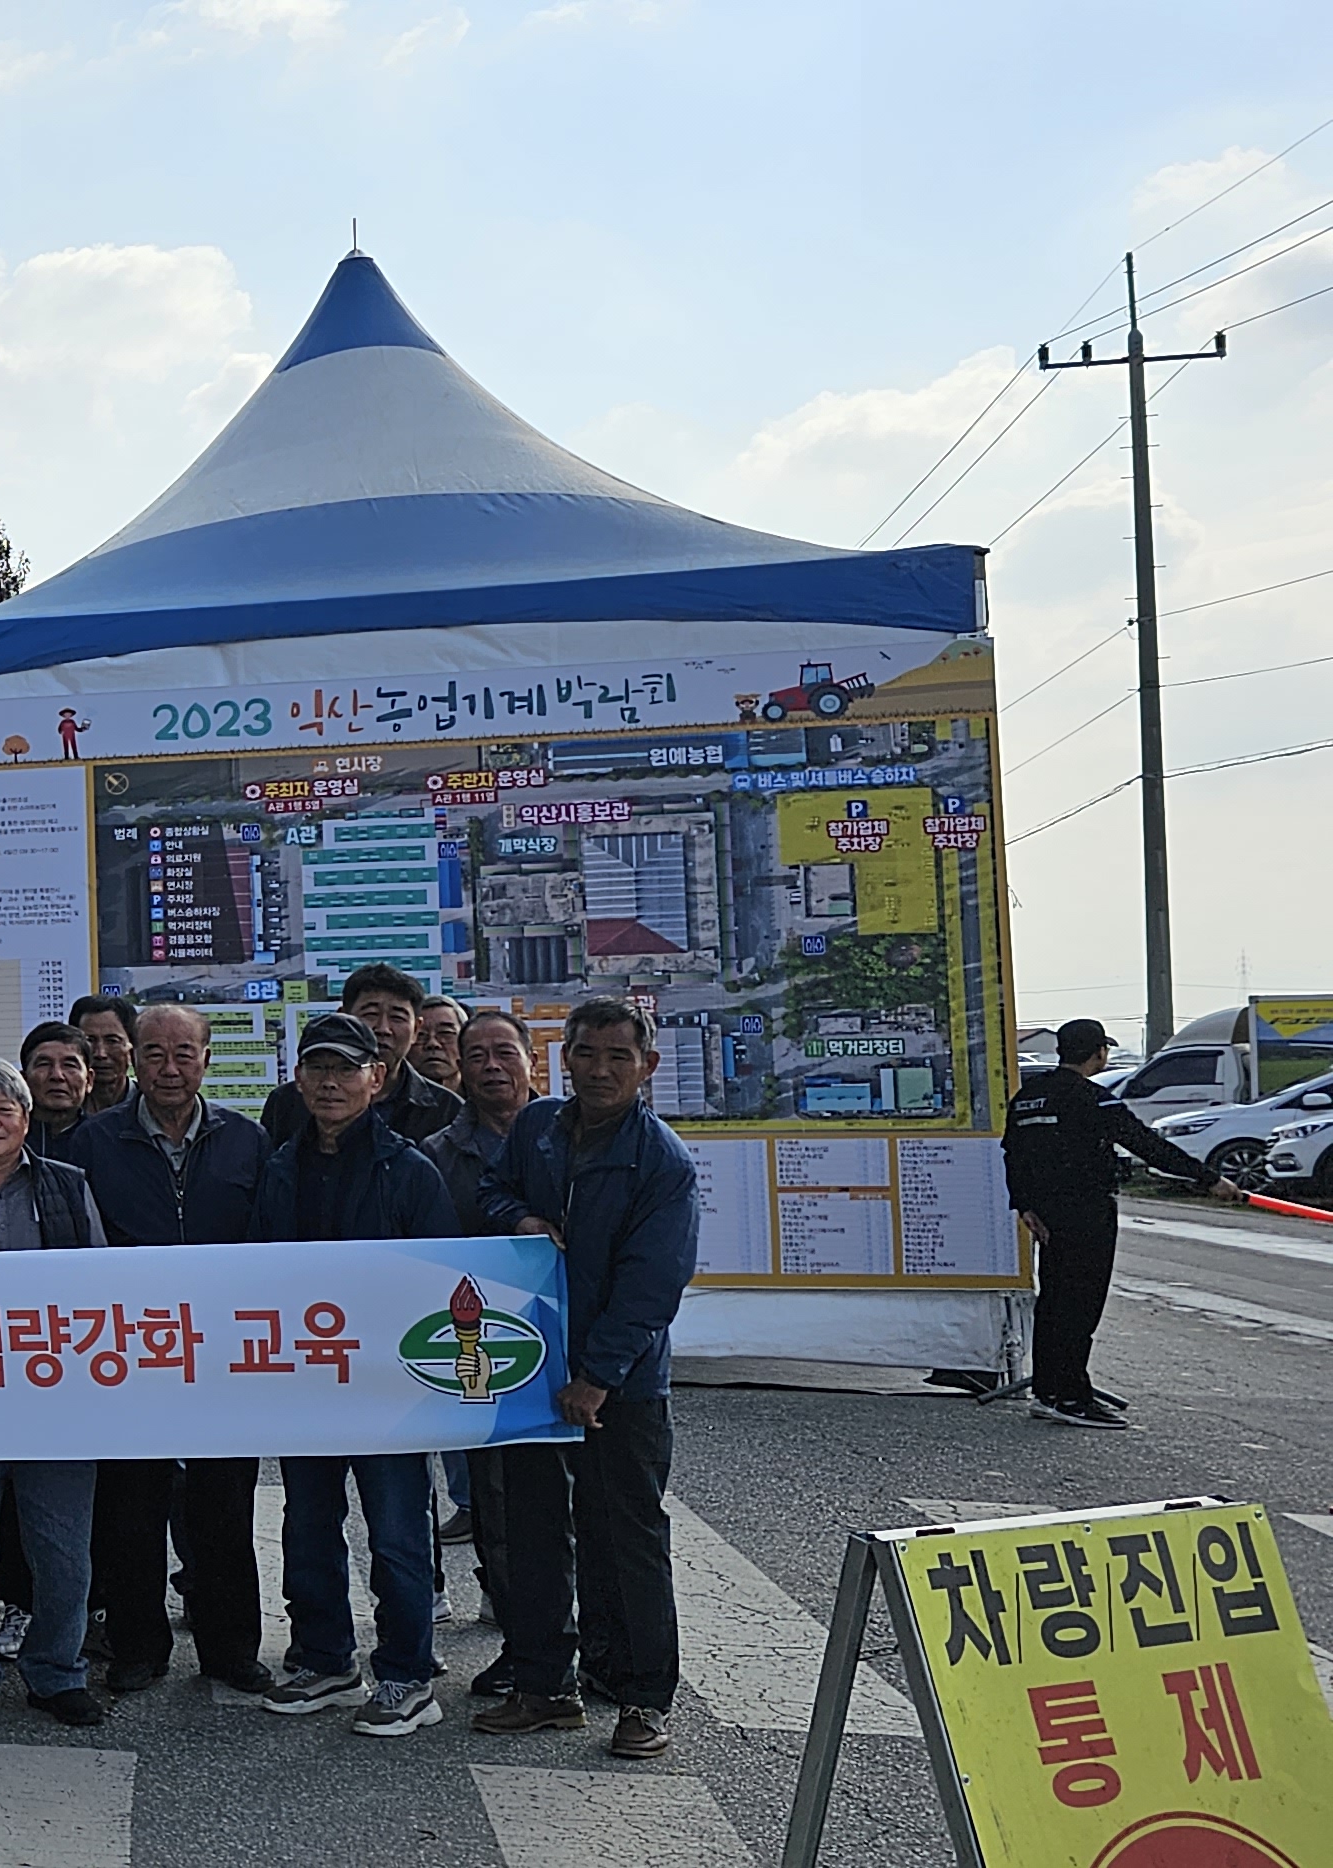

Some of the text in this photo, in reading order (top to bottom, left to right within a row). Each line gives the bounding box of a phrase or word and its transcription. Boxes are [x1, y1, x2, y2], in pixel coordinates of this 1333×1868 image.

[153, 698, 272, 740] 2023
[290, 689, 374, 736] 익산
[554, 673, 677, 724] 박람회
[335, 754, 383, 773] 연시장
[649, 745, 724, 766] 원예농협
[447, 769, 545, 789] 주관자 운영실
[757, 773, 787, 788] 버스
[871, 766, 916, 784] 승하차
[264, 778, 359, 798] 주최자 운영실
[520, 802, 631, 825] 익산시홍보관
[851, 803, 863, 817] P
[947, 799, 960, 813] P
[114, 828, 138, 840] 범례
[828, 820, 888, 836] 참가업체
[924, 817, 986, 833] 참가업체
[286, 826, 318, 846] A관
[836, 836, 882, 852] 주차장
[933, 832, 979, 849] 주차장
[164, 840, 183, 851] 안내
[166, 867, 194, 878] 화장실
[166, 880, 194, 892] 연시장
[166, 893, 194, 905] 주차장
[247, 979, 279, 1000] B관
[625, 994, 656, 1013] 관
[827, 1038, 905, 1056] 먹거리장터
[228, 1302, 361, 1384] 교육
[925, 1520, 1281, 1667] 차량진입
